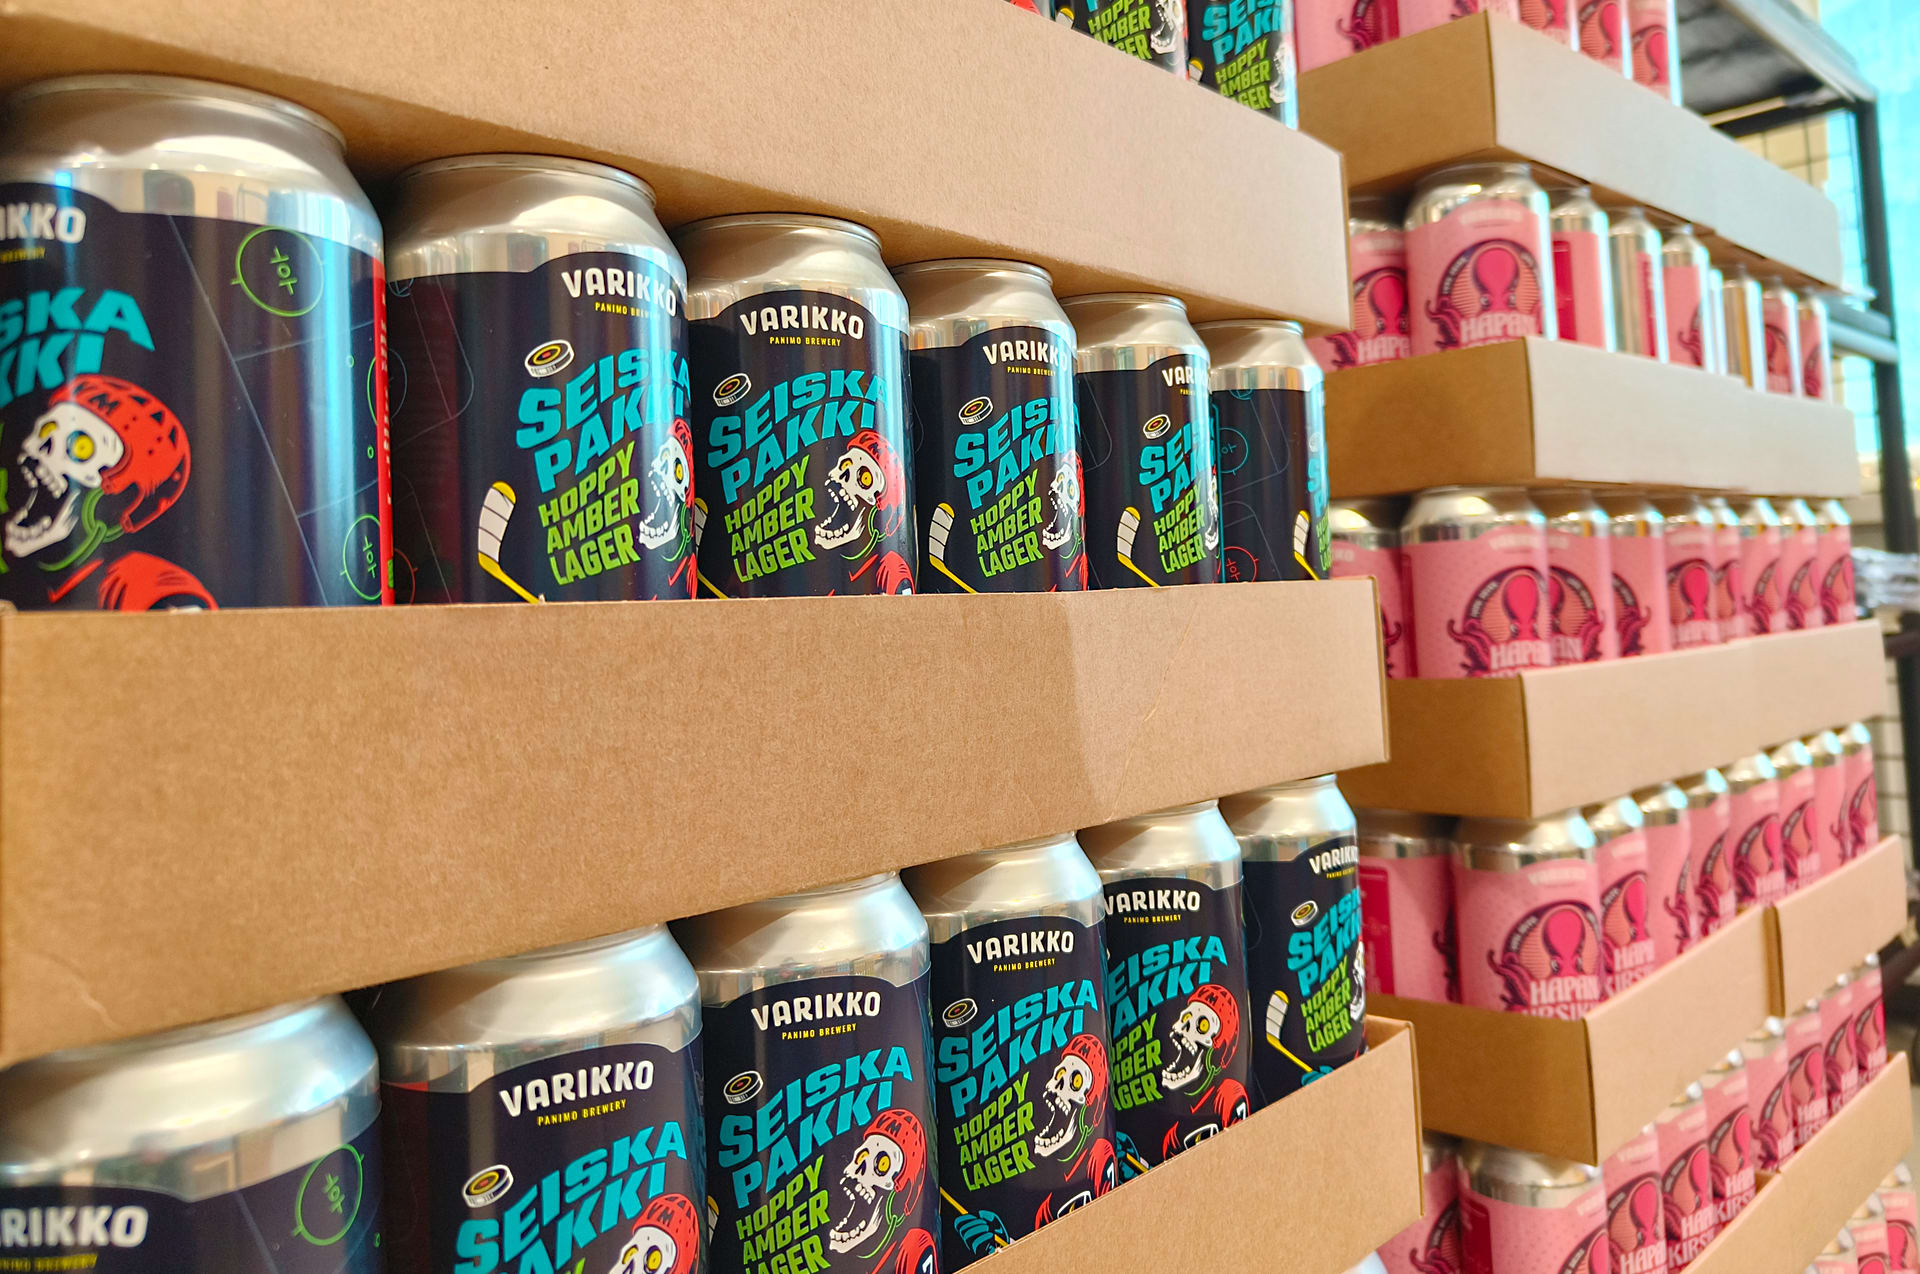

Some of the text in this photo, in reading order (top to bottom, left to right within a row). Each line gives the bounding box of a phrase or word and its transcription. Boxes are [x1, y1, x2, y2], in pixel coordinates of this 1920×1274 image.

[1215, 38, 1270, 84] HOPPY
[1219, 60, 1272, 97] AMBER
[561, 267, 677, 317] VARIKKO
[594, 302, 628, 315] PANIMO
[740, 304, 865, 340] VARIKKO
[769, 336, 841, 347] PANIMO BREWERY
[982, 340, 1068, 371] VARIKKO
[1007, 366, 1031, 375] PANIMO
[707, 369, 888, 469] SEISKA
[720, 400, 877, 505] PAKKI
[538, 441, 636, 527] HOPPY
[724, 454, 811, 534] HOPPY
[970, 468, 1039, 535] HOPPY
[1153, 480, 1202, 536] HOPPY
[547, 478, 641, 554] AMBER
[730, 487, 816, 557] AMBER
[976, 496, 1043, 555] AMBER
[1158, 503, 1206, 554] AMBER
[549, 525, 642, 586] LAGER
[732, 528, 817, 583] LAGER
[979, 536, 1044, 578] LAGER
[1160, 540, 1207, 574] LAGER
[1103, 889, 1201, 916] VARIKKO
[1123, 914, 1182, 924] PANIMO BREWERY
[967, 929, 1075, 964] VARIKKO
[993, 958, 1056, 972] PANIMO BREWERY
[750, 990, 882, 1031] VARIKKO
[1300, 954, 1349, 1018] HOPPY
[1305, 977, 1351, 1034] AMBER
[782, 1022, 857, 1040] PANIMO BREWERY
[937, 979, 1098, 1083] SEISKA
[1307, 1009, 1353, 1054] LAGER
[499, 1060, 654, 1117] VARIKKO
[950, 1008, 1085, 1118] PAKKI
[537, 1099, 627, 1127] PANIMO BREWERY
[718, 1046, 913, 1168] SEISKA
[953, 1071, 1030, 1145] HOPPY
[959, 1100, 1035, 1167] AMBER
[732, 1080, 893, 1209] PAKKI
[962, 1139, 1036, 1192] LAGER
[454, 1121, 687, 1274] SEISKA
[735, 1154, 824, 1241] HOPPY
[742, 1189, 831, 1266] AMBER
